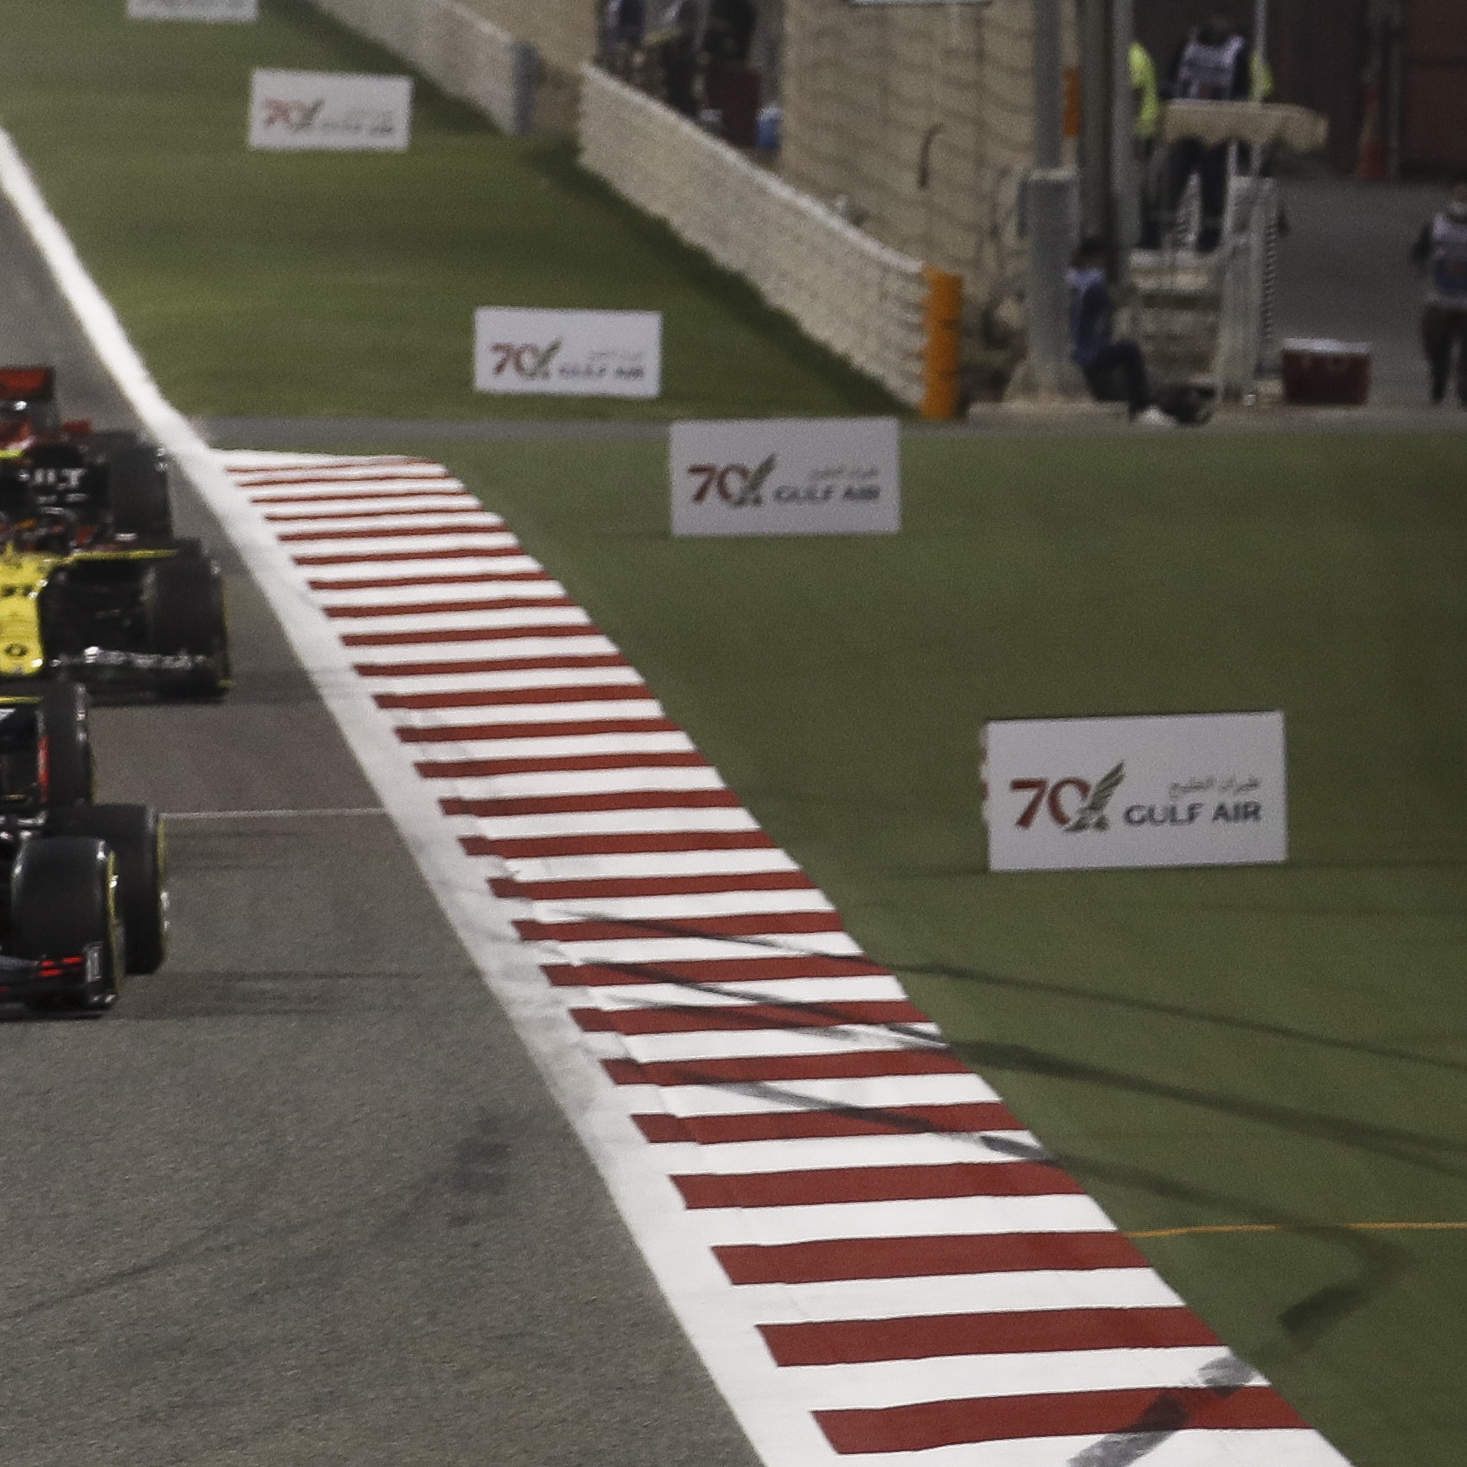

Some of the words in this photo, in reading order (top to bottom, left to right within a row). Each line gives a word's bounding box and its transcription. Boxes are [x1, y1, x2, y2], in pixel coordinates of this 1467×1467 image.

[686, 462, 751, 506] 70
[1009, 776, 1091, 830] 70
[1122, 802, 1205, 827] GULF
[1210, 799, 1263, 824] AIR
